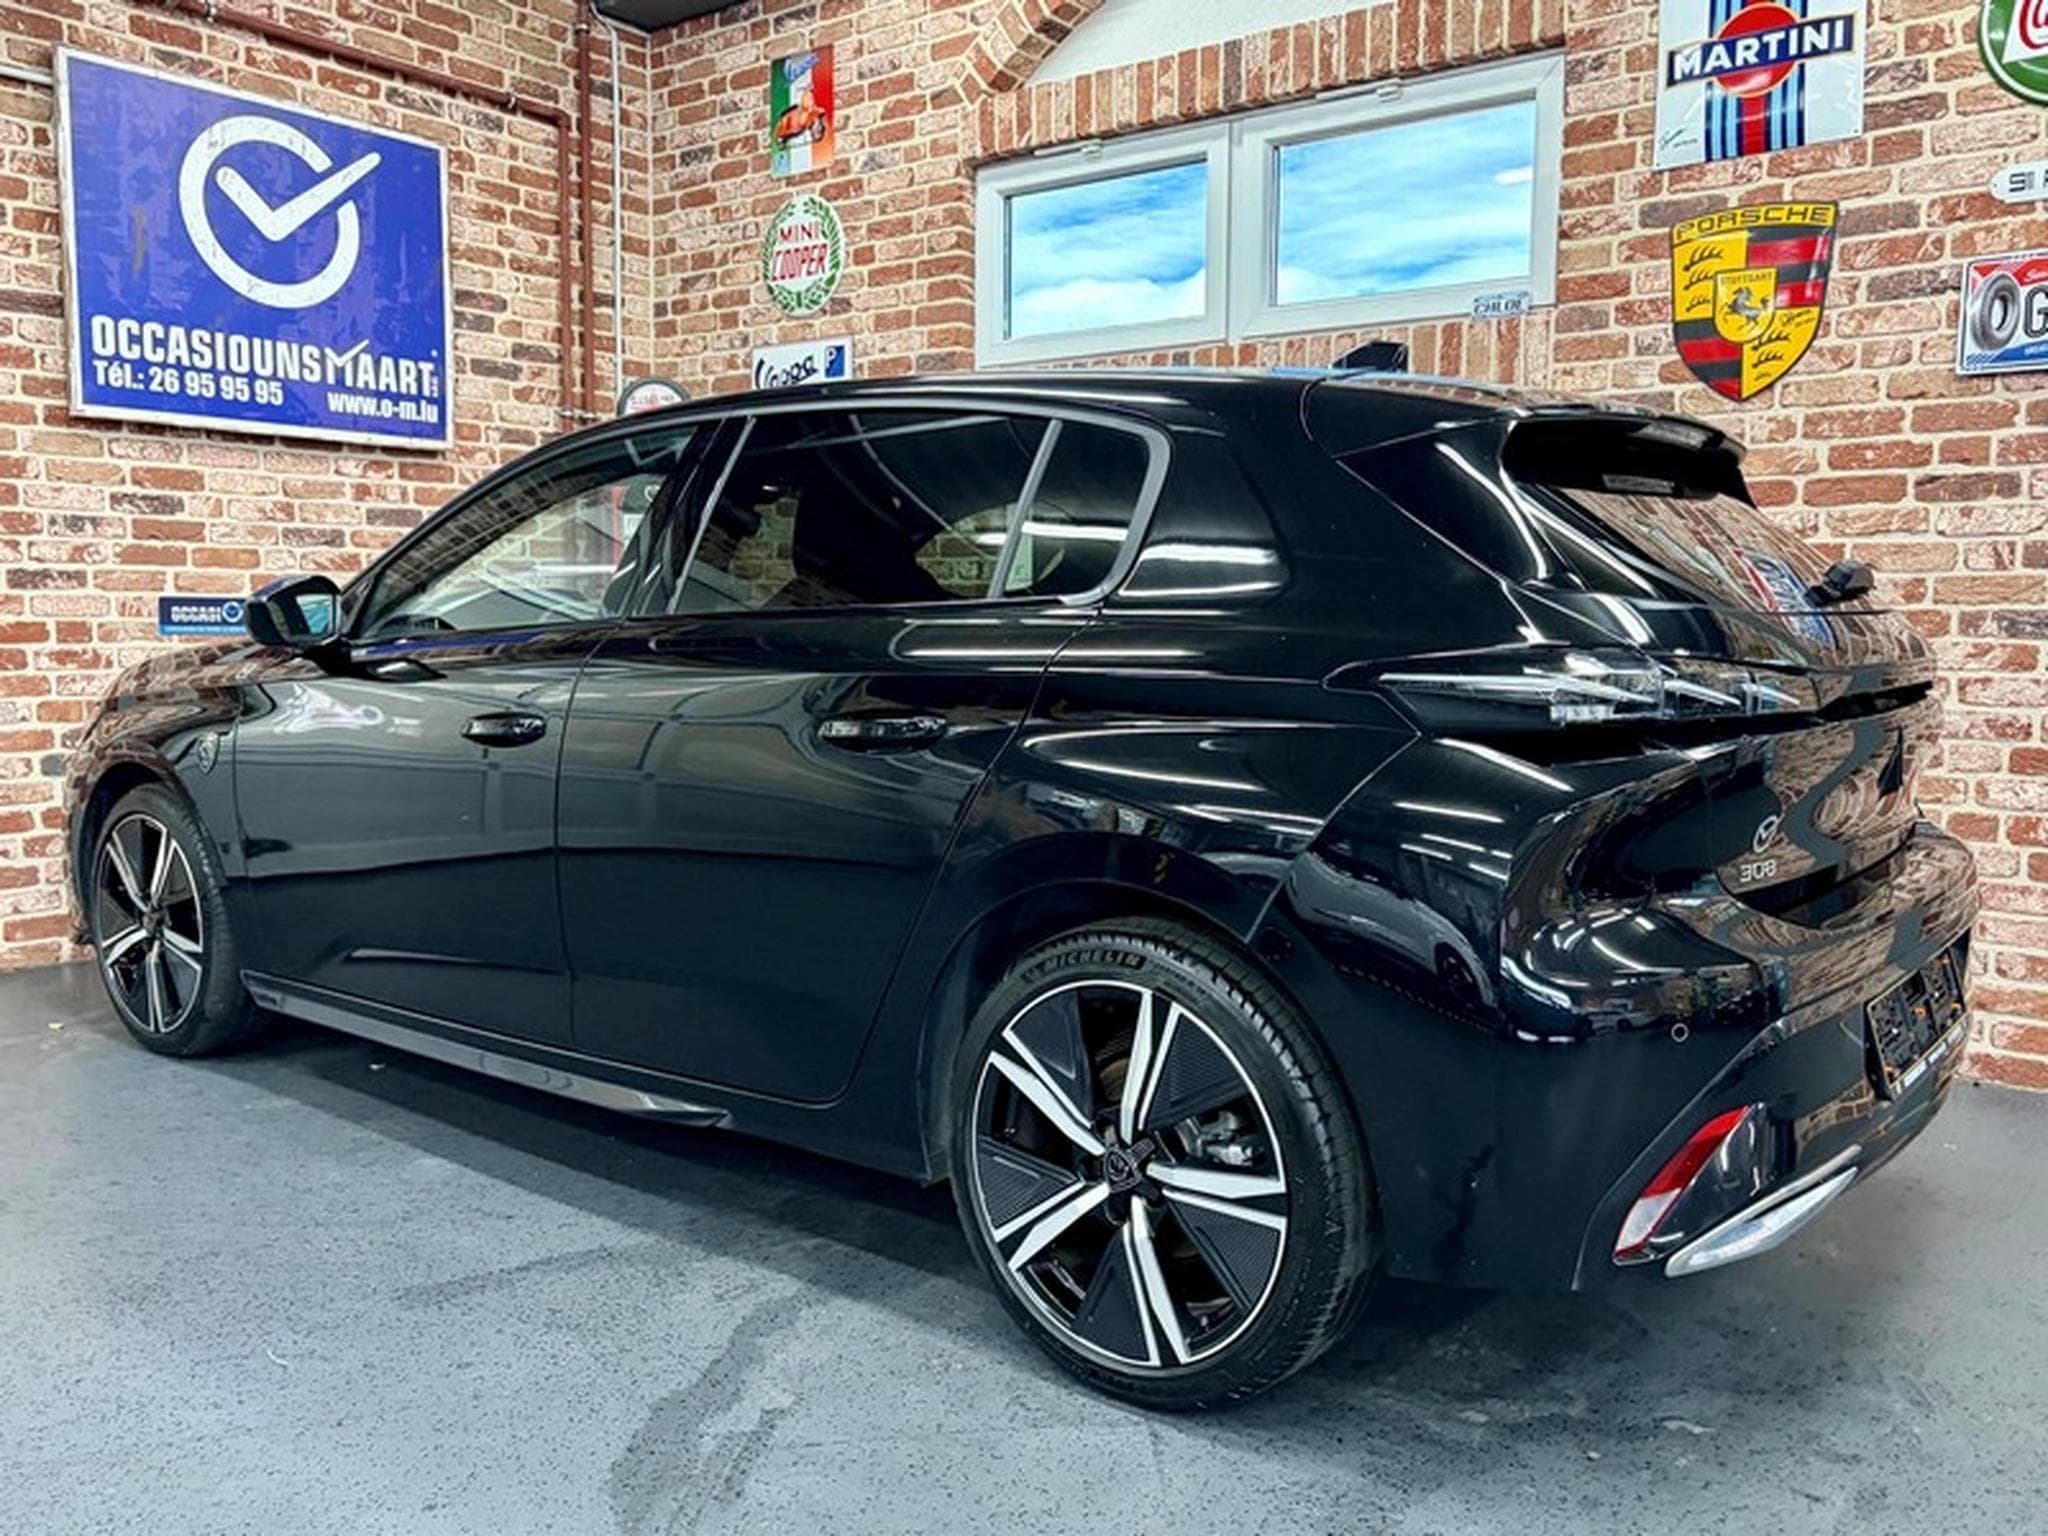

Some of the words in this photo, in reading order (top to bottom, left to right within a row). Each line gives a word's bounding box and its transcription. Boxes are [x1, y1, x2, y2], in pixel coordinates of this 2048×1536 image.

[1673, 19, 1845, 81] MARTINI
[780, 220, 820, 243] MINI
[1677, 206, 1831, 241] PORSCHE
[771, 243, 828, 282] COOPER
[92, 359, 144, 390] Tél.:
[149, 365, 180, 395] 26
[184, 370, 217, 399] 95
[219, 374, 251, 403] 95
[253, 378, 284, 406] 95
[327, 391, 440, 424] www.o-m.lu
[1739, 859, 1777, 883] 308
